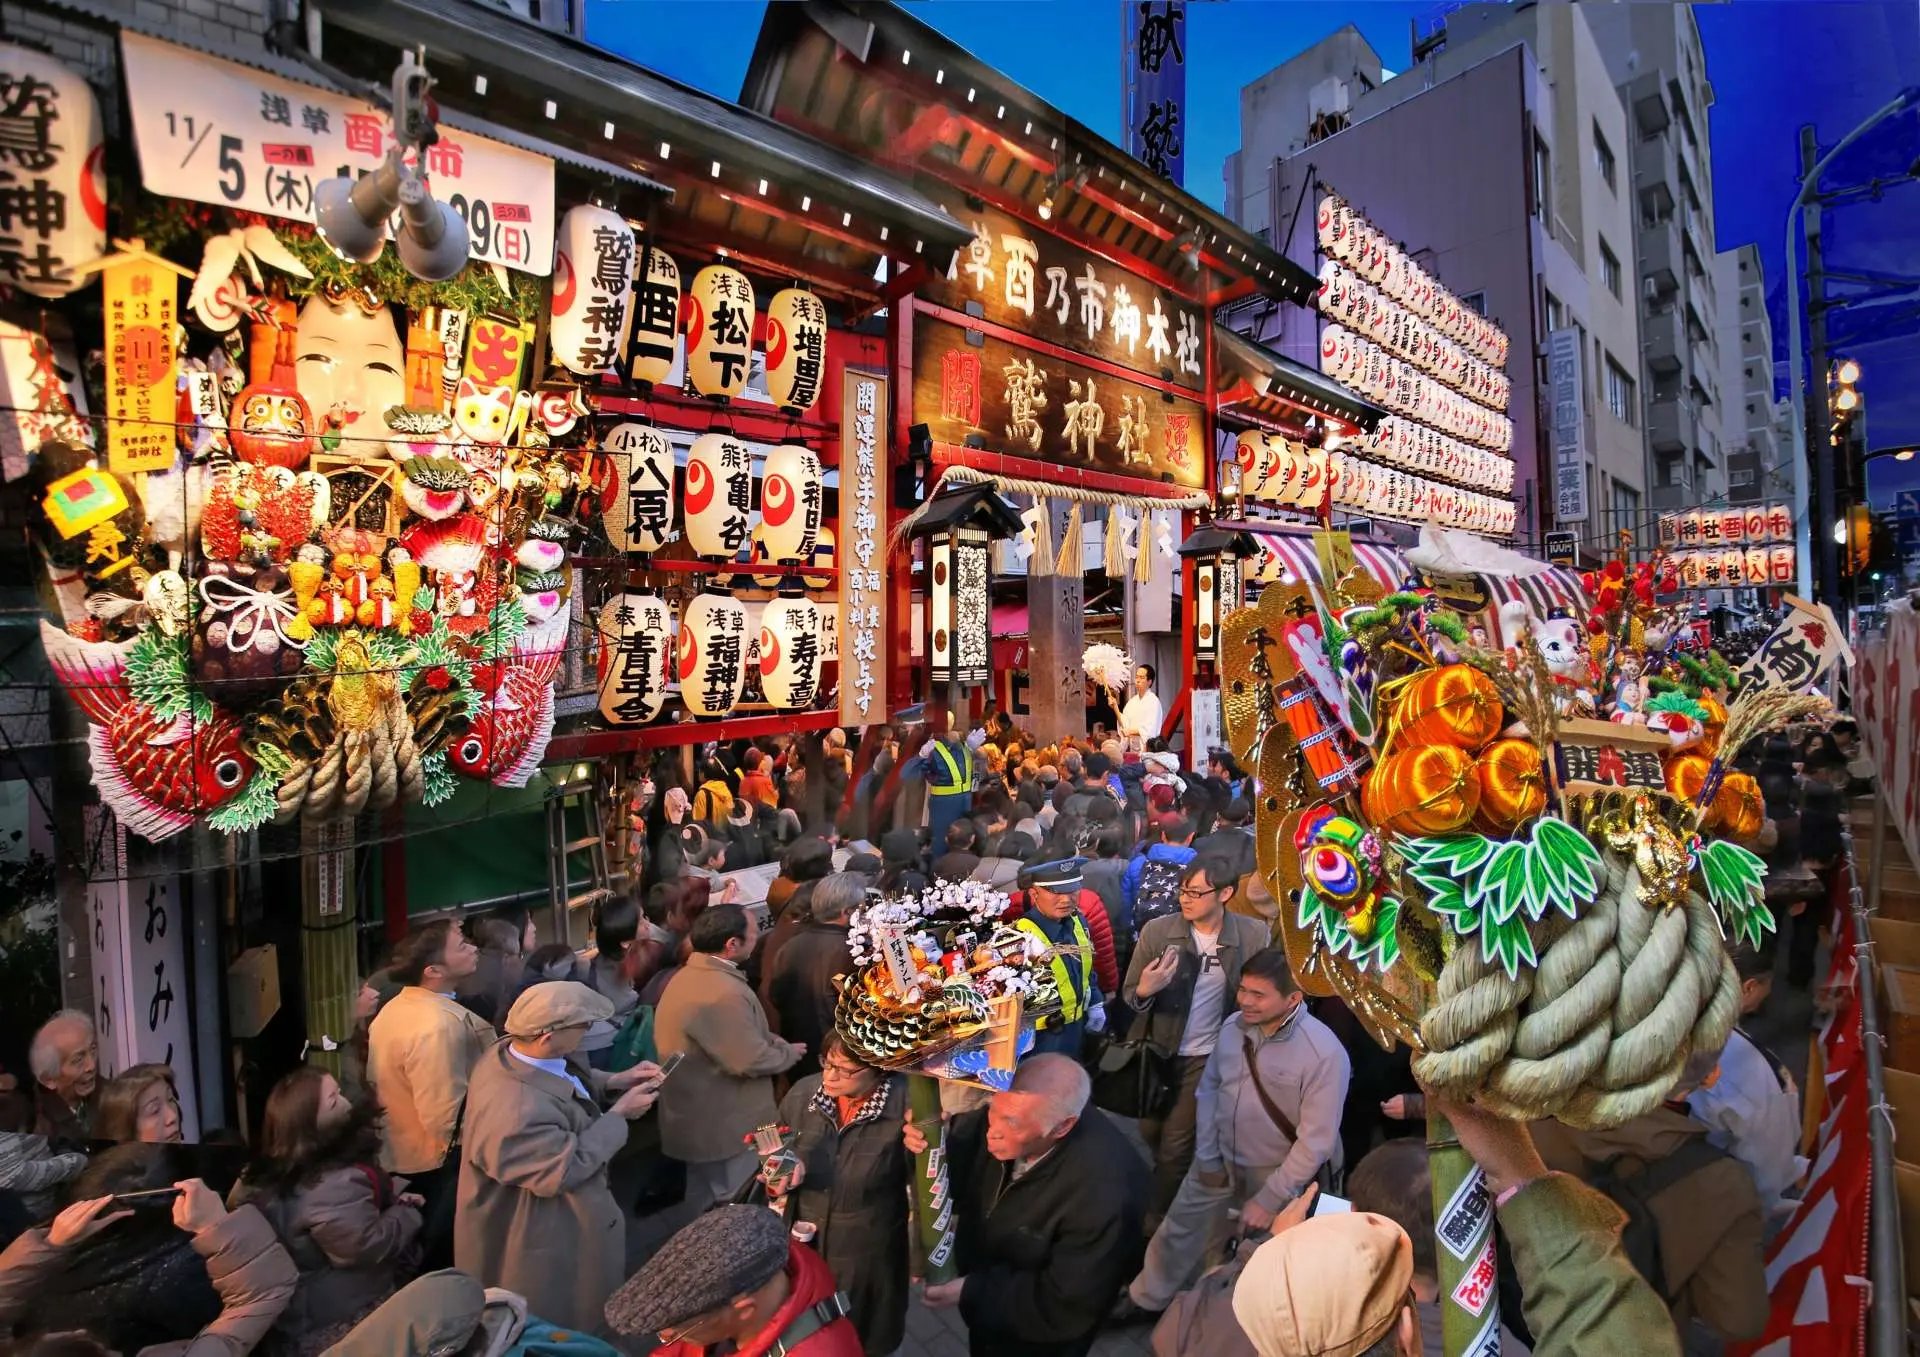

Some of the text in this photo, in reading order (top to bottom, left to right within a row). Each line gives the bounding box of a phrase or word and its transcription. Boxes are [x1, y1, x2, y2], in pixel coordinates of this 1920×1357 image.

[261, 92, 464, 178] 浅草 酉市
[576, 225, 633, 369] 鷲神社
[711, 273, 750, 304] 浅草
[792, 297, 825, 325] 浅草
[946, 220, 1200, 376] 草酉乃市御本社
[709, 301, 750, 388] 松下
[787, 325, 822, 408] 増田屋
[1003, 357, 1153, 466] 鷲神社
[1553, 336, 1580, 491] 三和自動車工業
[801, 455, 822, 479] 浅
[853, 382, 877, 567] 開運熊手御守
[86, 520, 126, 564] 寿
[719, 471, 750, 550] 亀谷
[1661, 513, 1787, 541] 鷲神社酉の市
[615, 606, 662, 632] 奉賛
[706, 608, 744, 632] 浅草
[786, 607, 818, 630] 熊手
[612, 631, 658, 721] 青年会
[702, 635, 740, 712] 福神講
[786, 632, 818, 707] 寿々喜
[853, 629, 876, 716] 授与す
